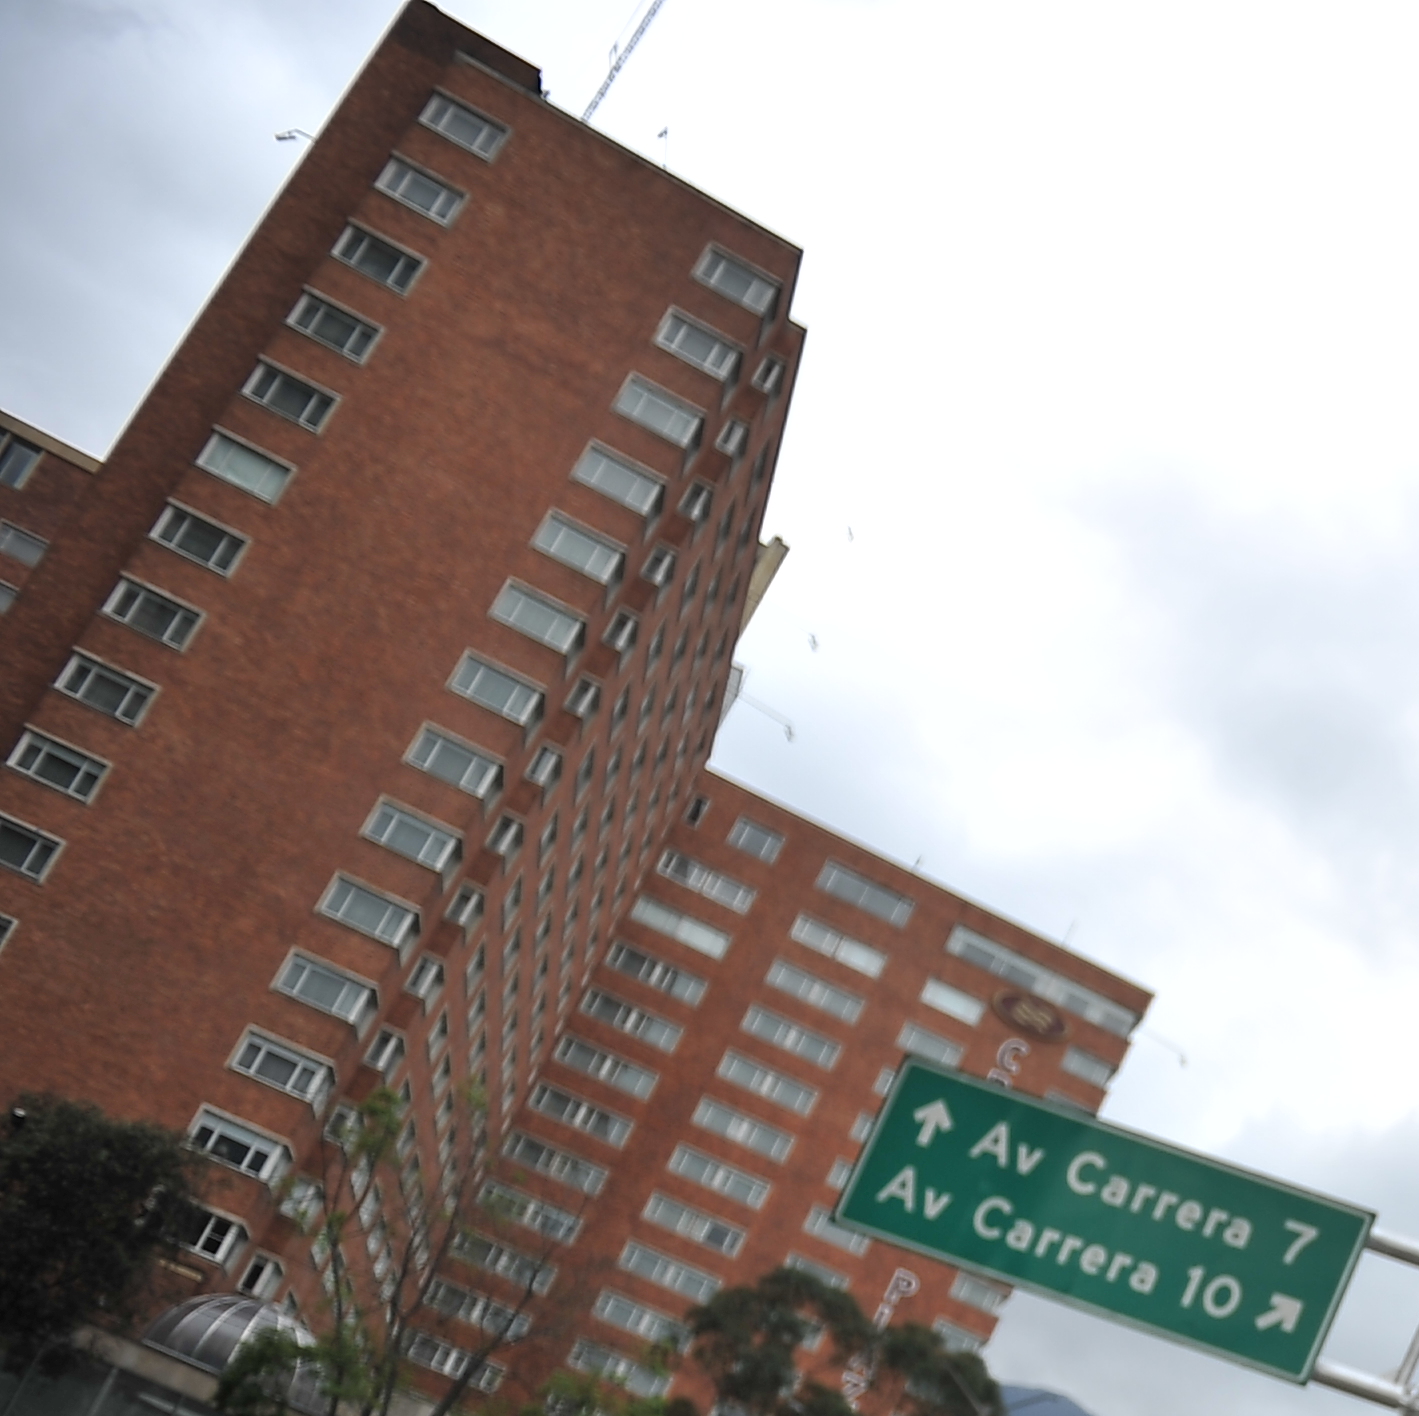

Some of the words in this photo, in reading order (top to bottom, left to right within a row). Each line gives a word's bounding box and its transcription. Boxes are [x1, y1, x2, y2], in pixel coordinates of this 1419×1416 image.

[876, 1165, 952, 1221] Av
[972, 1196, 1160, 1295] Carrera
[1180, 1265, 1242, 1319] 10
[968, 1120, 1045, 1176] Av
[1065, 1150, 1252, 1250] Carrera
[1282, 1219, 1319, 1265] 7
